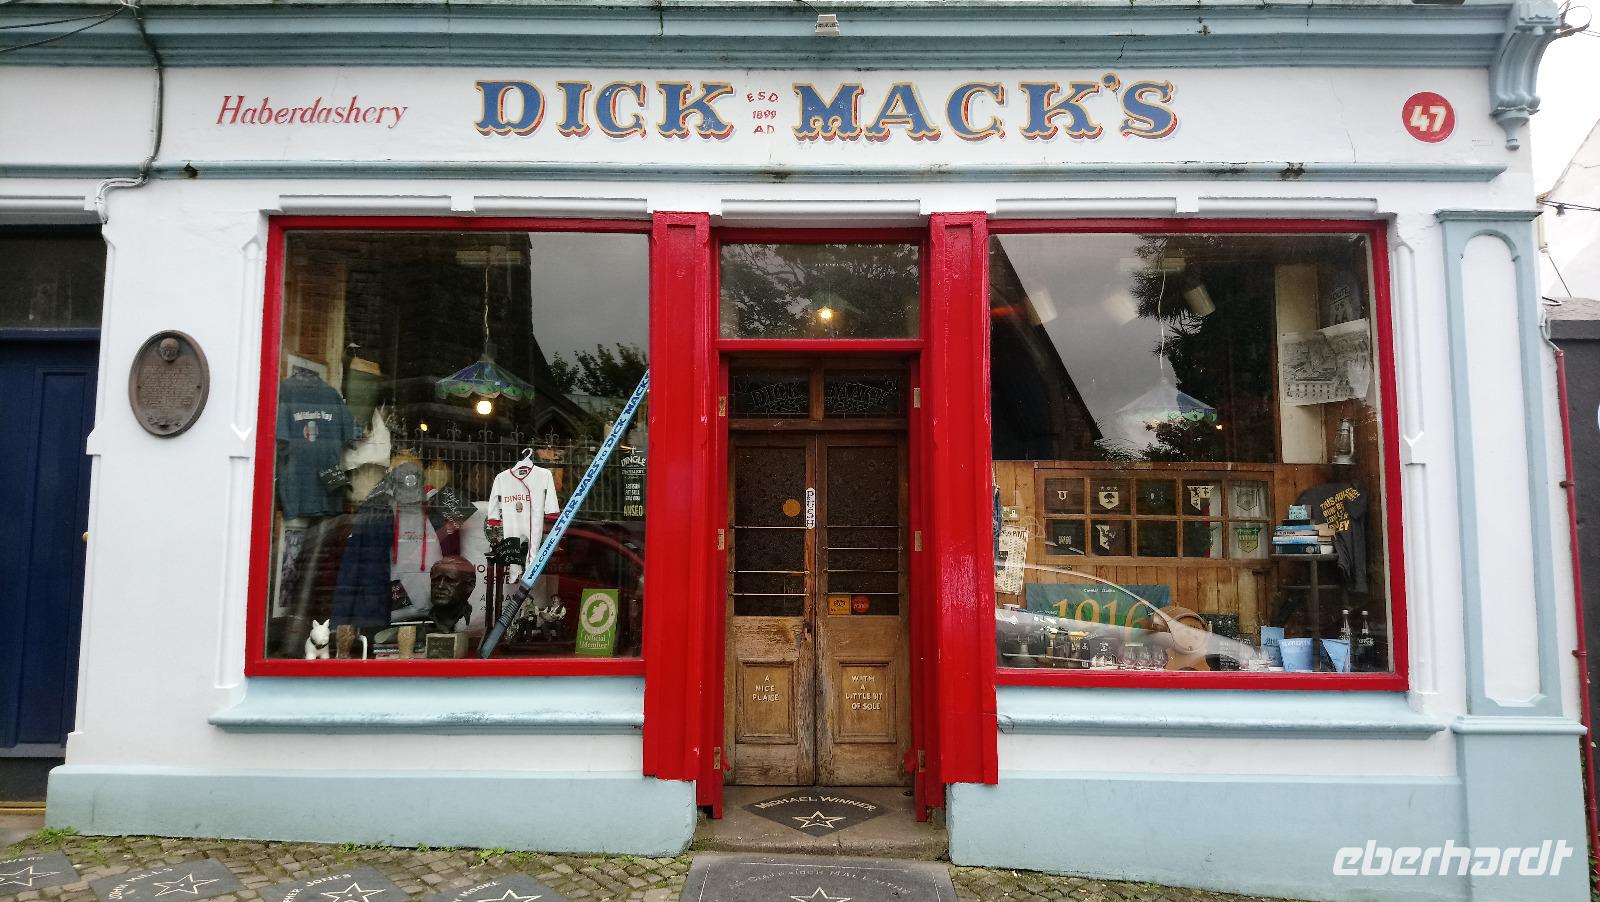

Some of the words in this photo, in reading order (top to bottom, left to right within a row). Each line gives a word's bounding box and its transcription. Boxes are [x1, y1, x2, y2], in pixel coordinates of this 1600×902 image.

[216, 95, 408, 129] Haberdashery
[474, 80, 735, 142] DICK
[790, 71, 1179, 144] MACK'S
[752, 109, 777, 120] 1899
[1409, 105, 1448, 132] 47
[504, 494, 531, 503] DINGLE
[527, 538, 556, 580] WELCOME
[554, 497, 580, 537] STAR
[575, 460, 603, 498] WARS
[598, 450, 608, 461] TO
[604, 418, 627, 450] DICK
[764, 674, 771, 682] A
[845, 692, 869, 700] LITTLE
[851, 702, 862, 710] OF
[862, 702, 881, 710] SOLE
[754, 796, 818, 809] MICHAEL
[819, 795, 877, 812] WINNER
[108, 883, 129, 900] JOHN
[125, 867, 173, 882] MILLS
[306, 873, 352, 887] JONES
